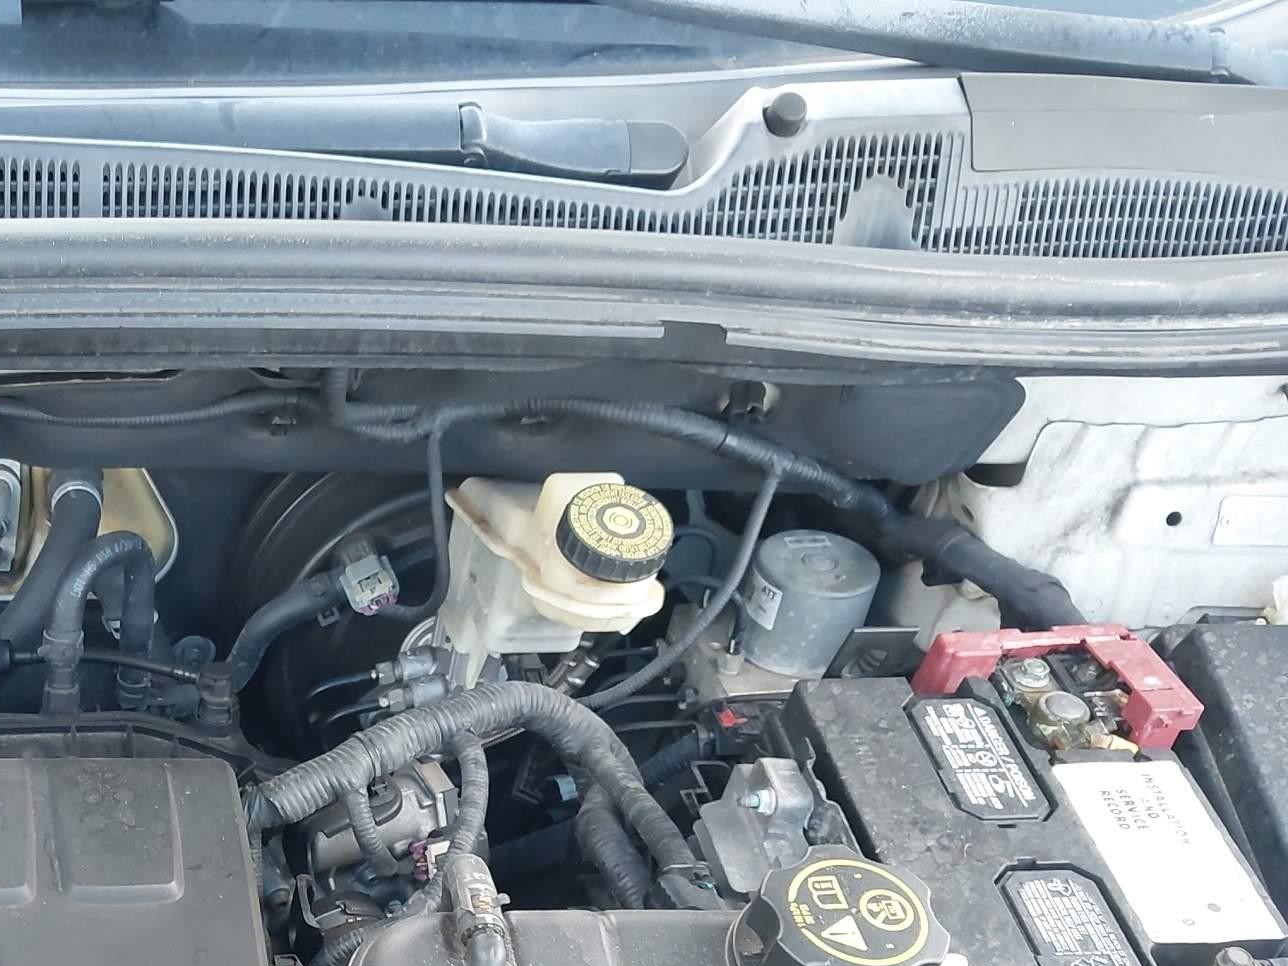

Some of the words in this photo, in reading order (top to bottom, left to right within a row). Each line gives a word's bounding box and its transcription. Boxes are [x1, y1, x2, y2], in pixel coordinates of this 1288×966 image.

[978, 716, 1010, 756] DANGER
[1006, 763, 1037, 801] POISON
[1100, 790, 1131, 831] RECORD
[1116, 788, 1149, 831] SERVICE
[1141, 773, 1191, 845] INSTALLATION
